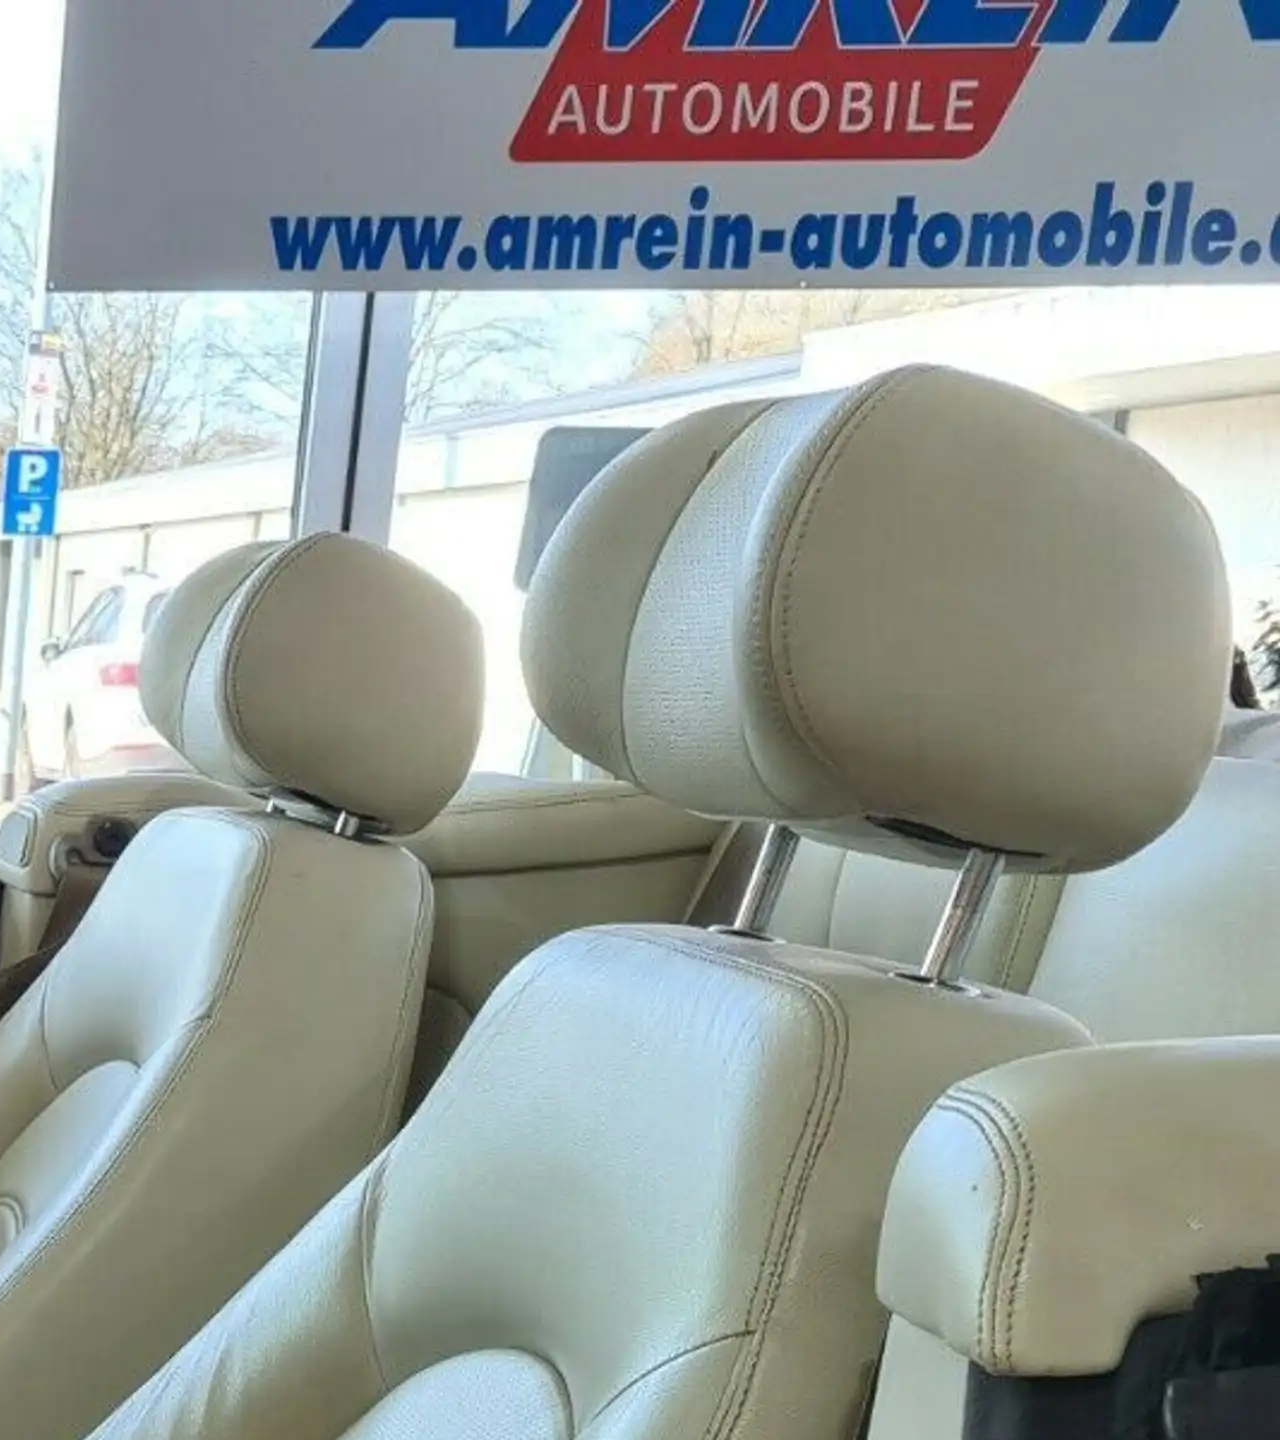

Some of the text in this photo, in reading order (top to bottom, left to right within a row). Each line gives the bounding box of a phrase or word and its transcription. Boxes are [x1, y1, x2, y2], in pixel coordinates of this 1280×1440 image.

[547, 79, 980, 137] AUTOMOBILE
[269, 180, 1280, 271] www.amrein-automobile.
[17, 454, 50, 494] P
